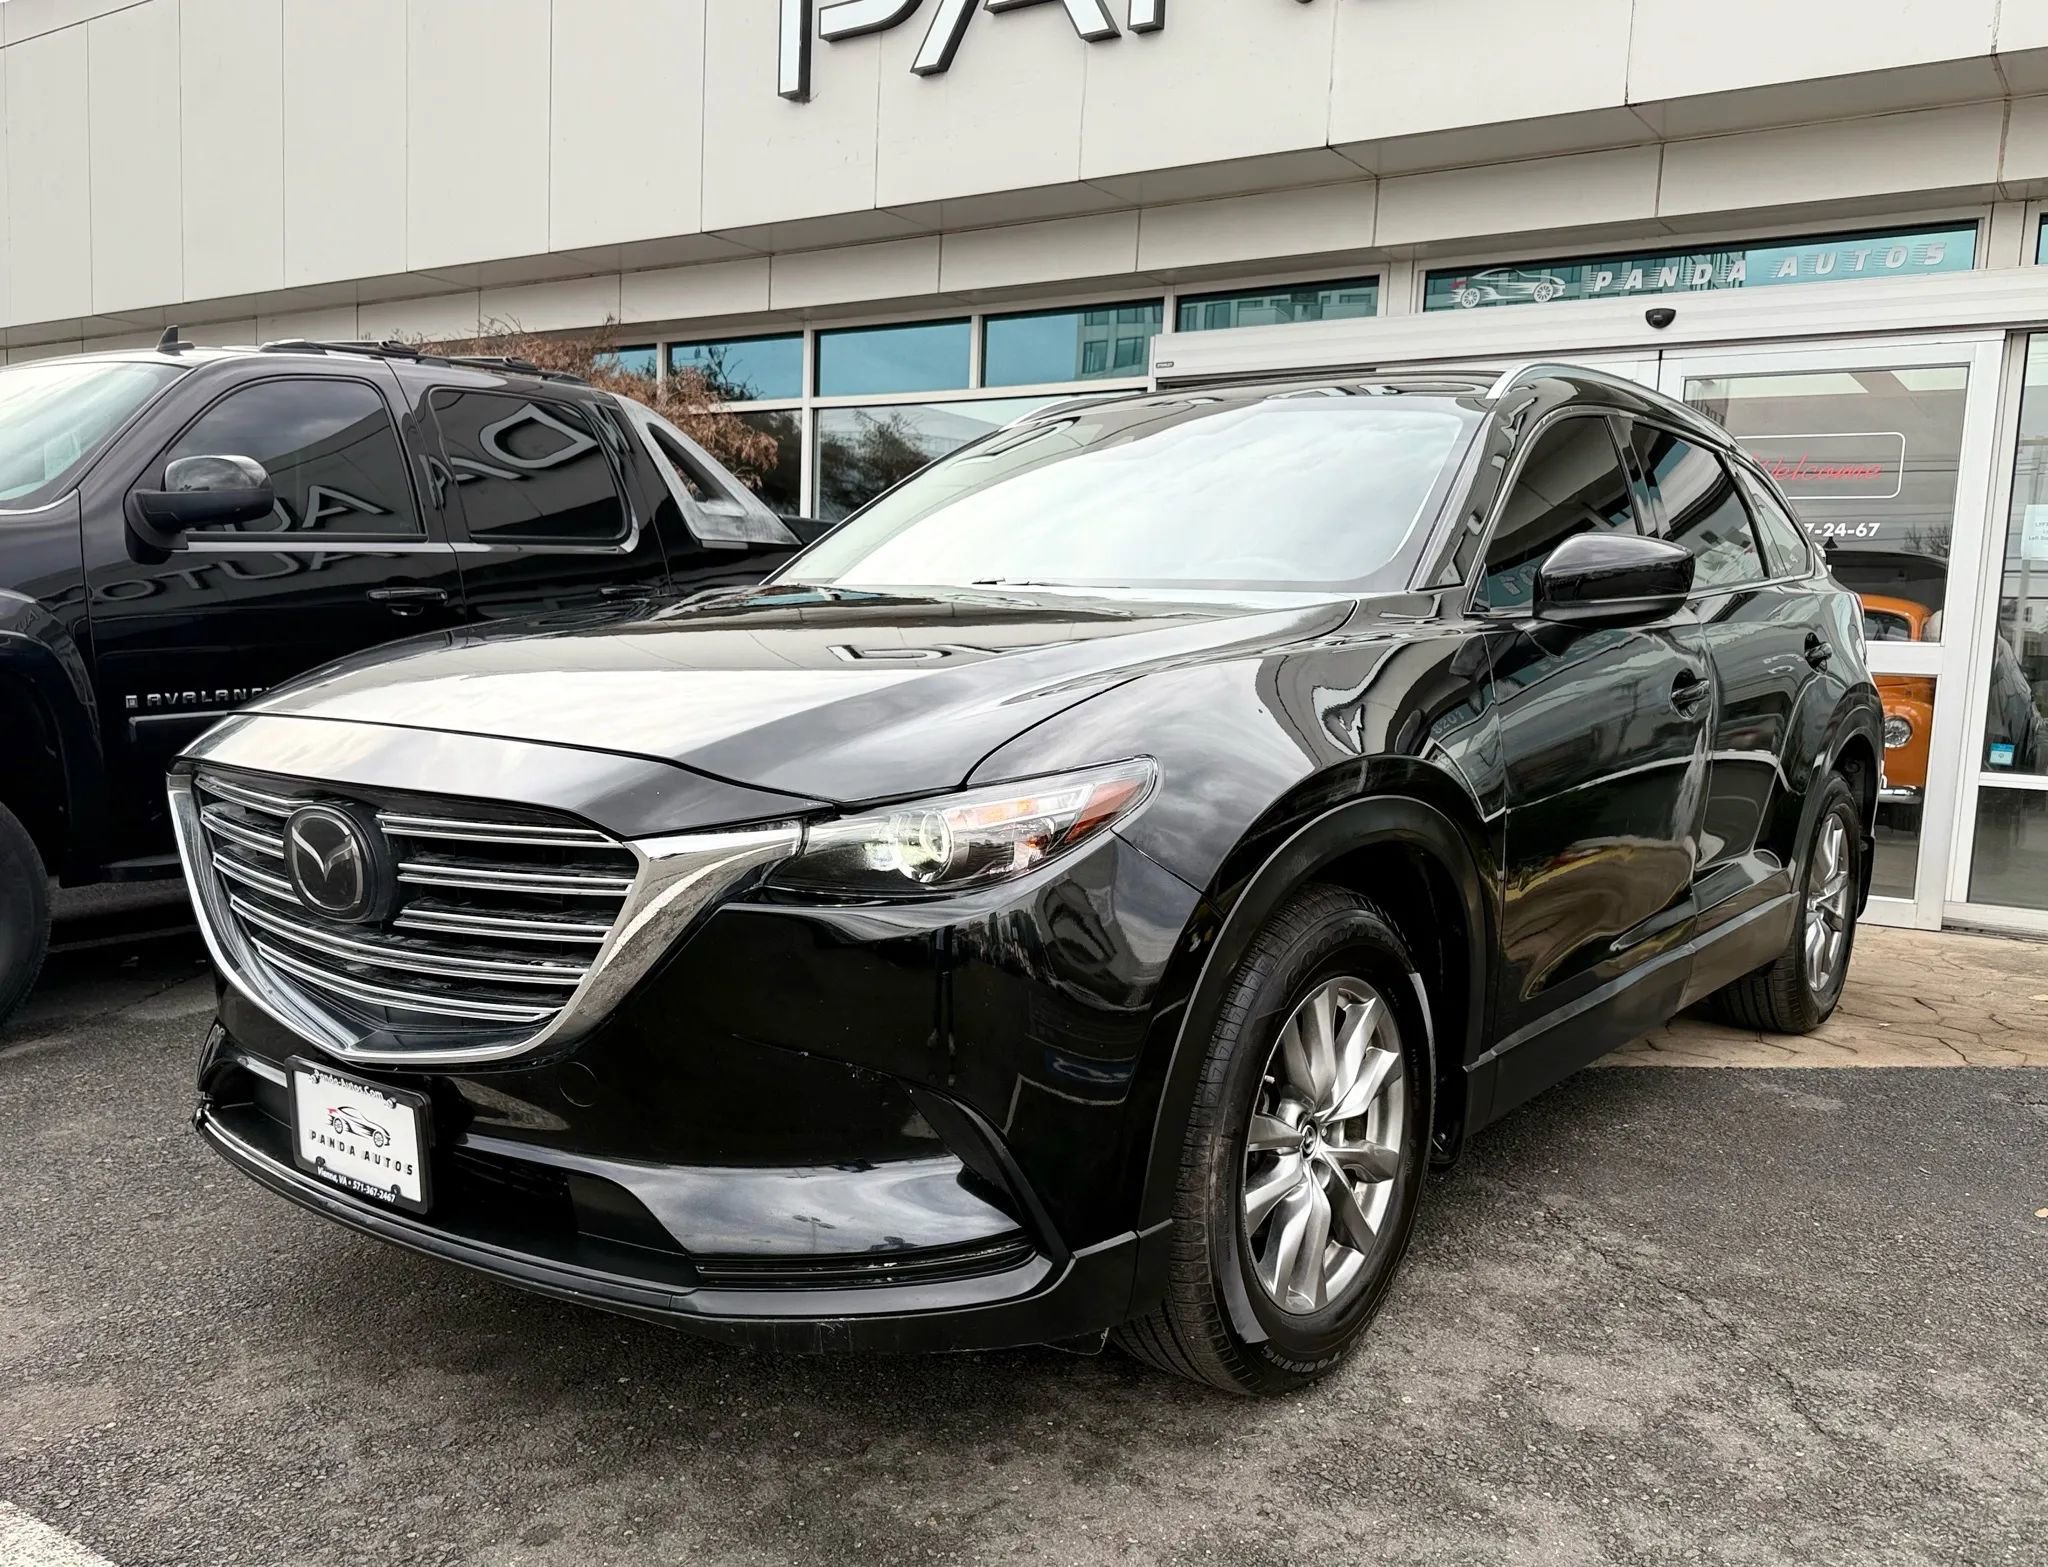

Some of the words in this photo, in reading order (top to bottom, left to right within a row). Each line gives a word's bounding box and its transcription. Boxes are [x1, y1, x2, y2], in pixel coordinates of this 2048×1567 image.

[1584, 260, 1746, 292] PANDA
[1770, 242, 1947, 279] AUTOS
[310, 1131, 356, 1157] PANDA
[363, 1150, 413, 1176] AUTOS
[353, 1180, 396, 1203] 571-367-2467
